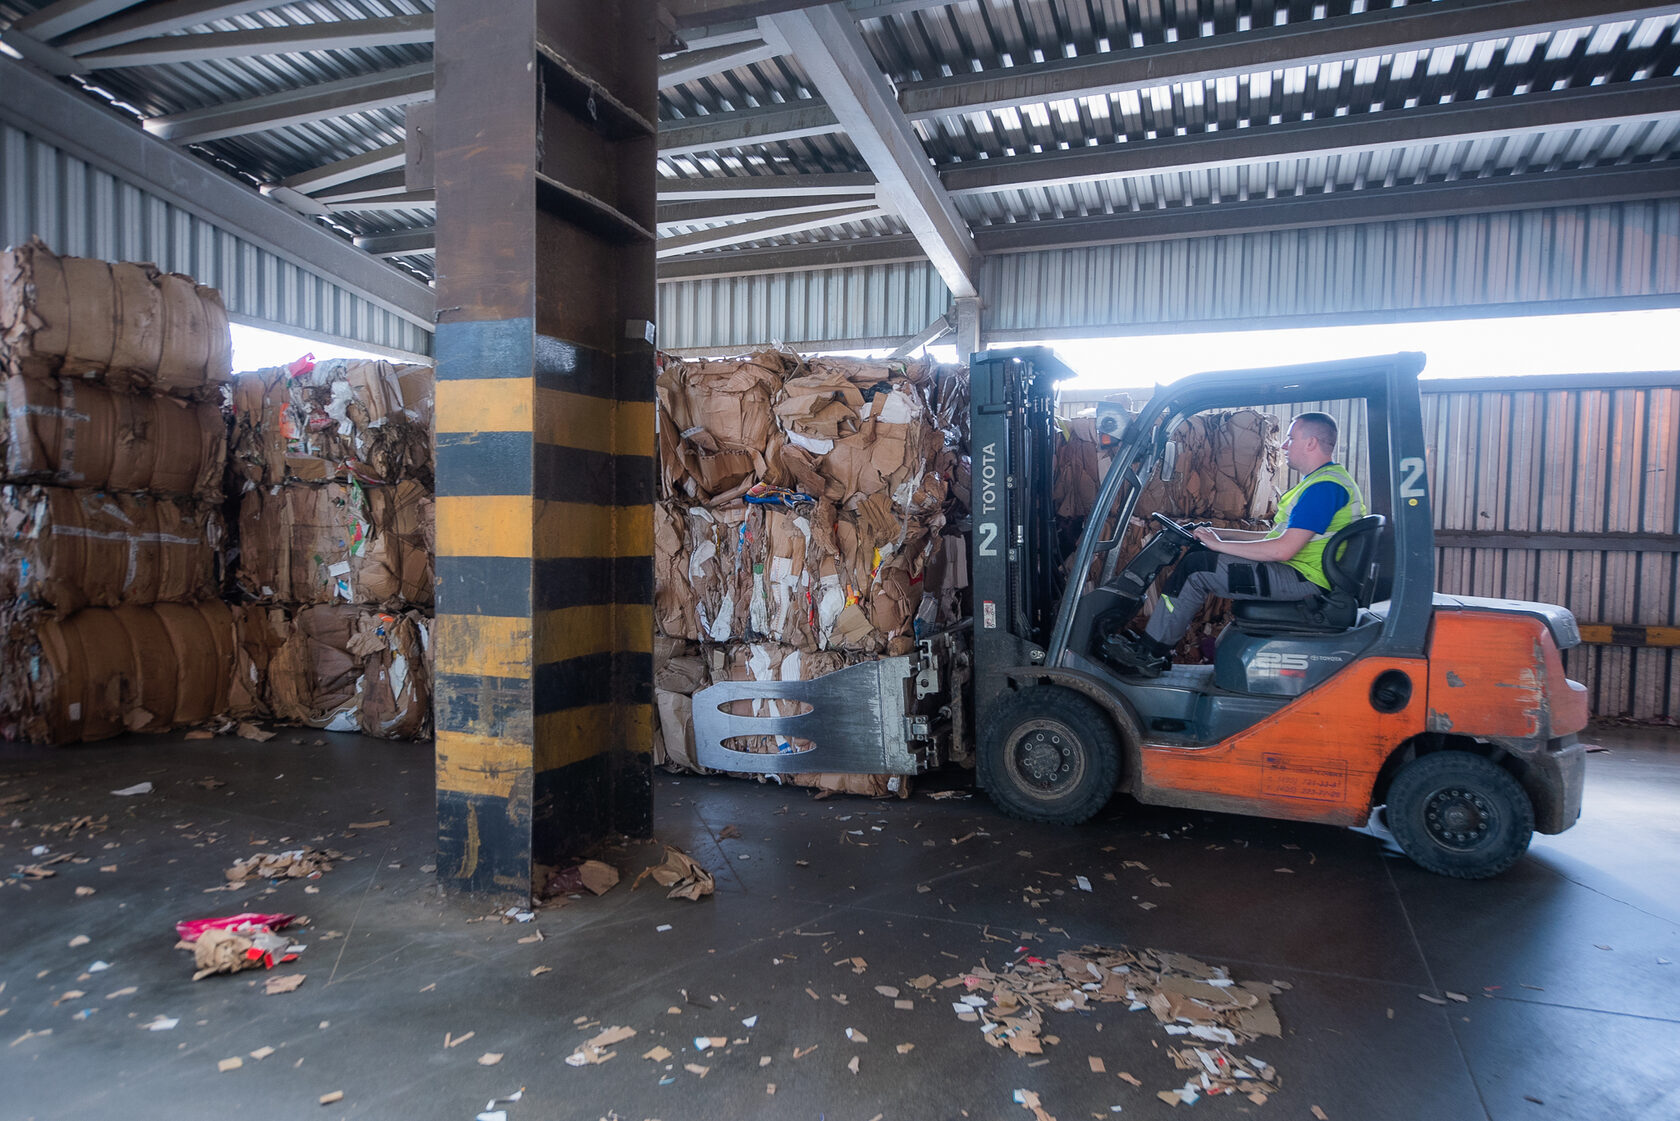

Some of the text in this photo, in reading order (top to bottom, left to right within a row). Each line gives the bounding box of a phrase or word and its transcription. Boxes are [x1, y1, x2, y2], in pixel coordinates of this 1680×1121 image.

[982, 442, 996, 515] TOYOTA
[1399, 456, 1425, 498] 2
[979, 522, 998, 557] 2
[1255, 652, 1309, 670] 25
